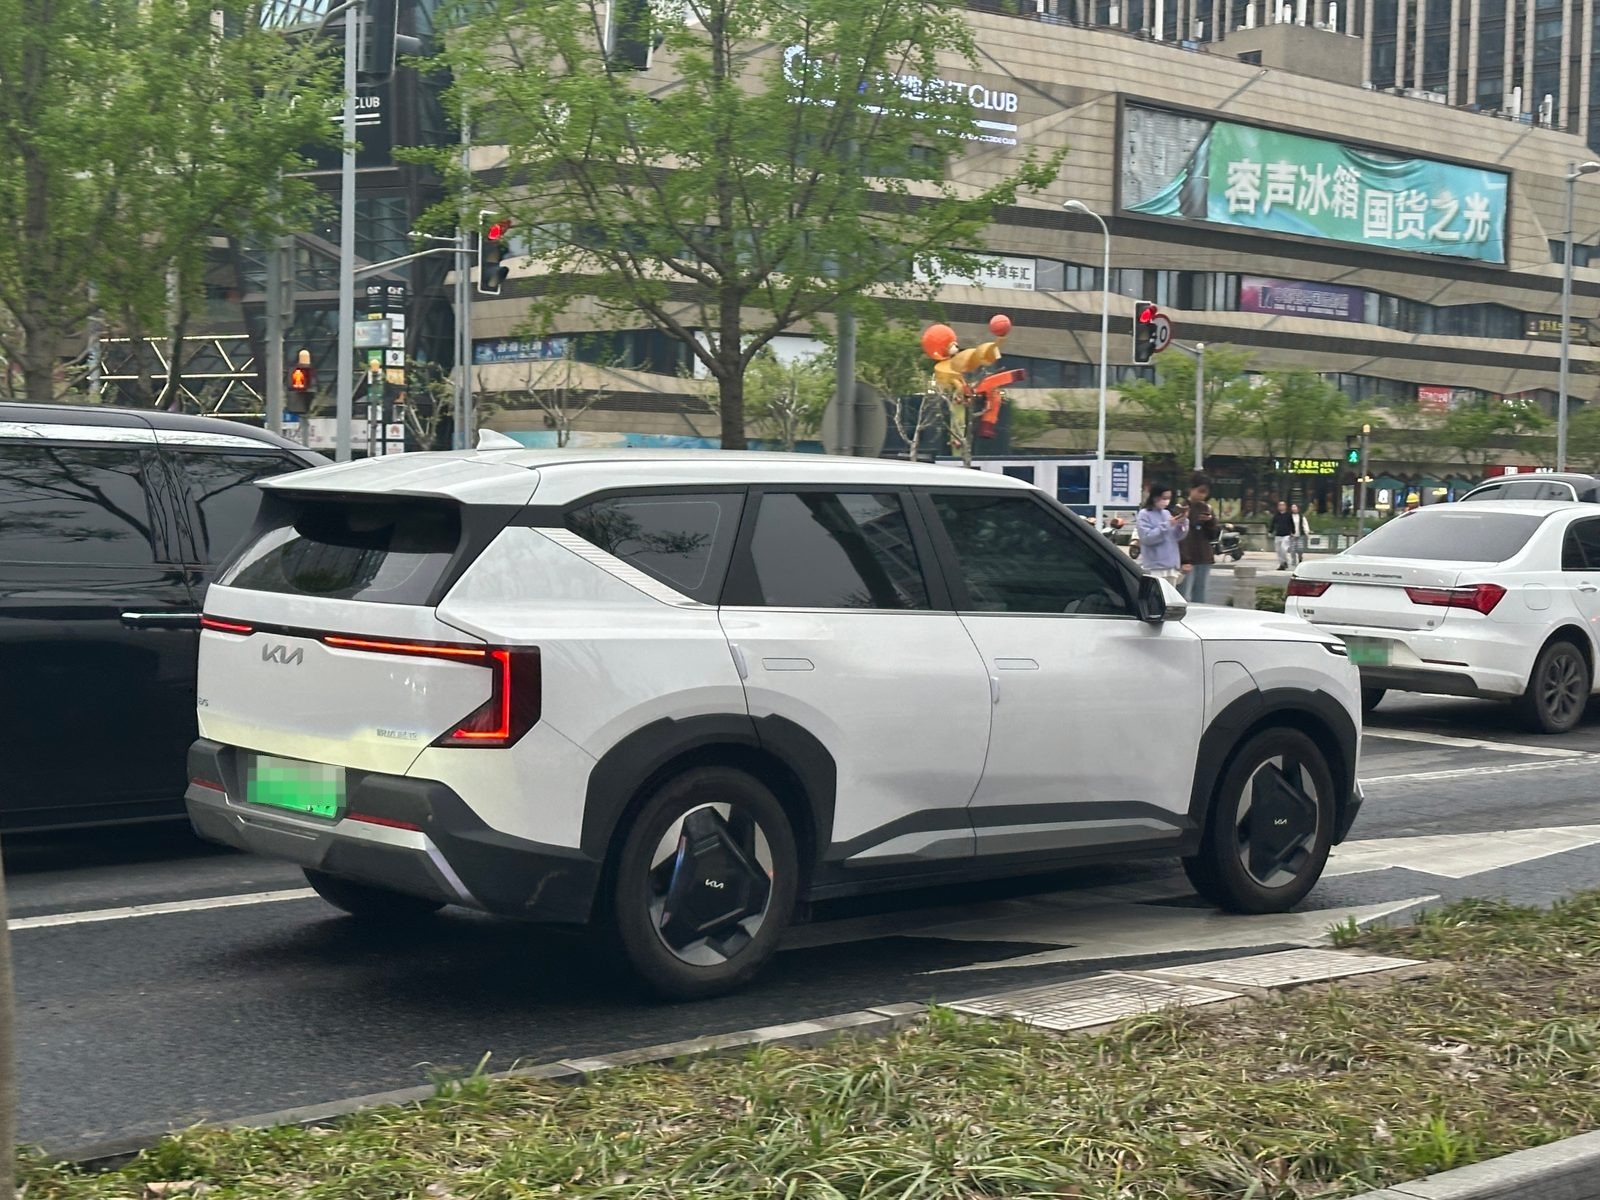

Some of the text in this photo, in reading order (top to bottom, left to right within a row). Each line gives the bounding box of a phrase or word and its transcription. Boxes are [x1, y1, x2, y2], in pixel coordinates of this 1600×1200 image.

[968, 84, 1018, 113] CLUB
[1225, 157, 1492, 242] 容声冰箱 国货之光
[263, 643, 304, 666] KIA
[706, 879, 724, 889] KIA
